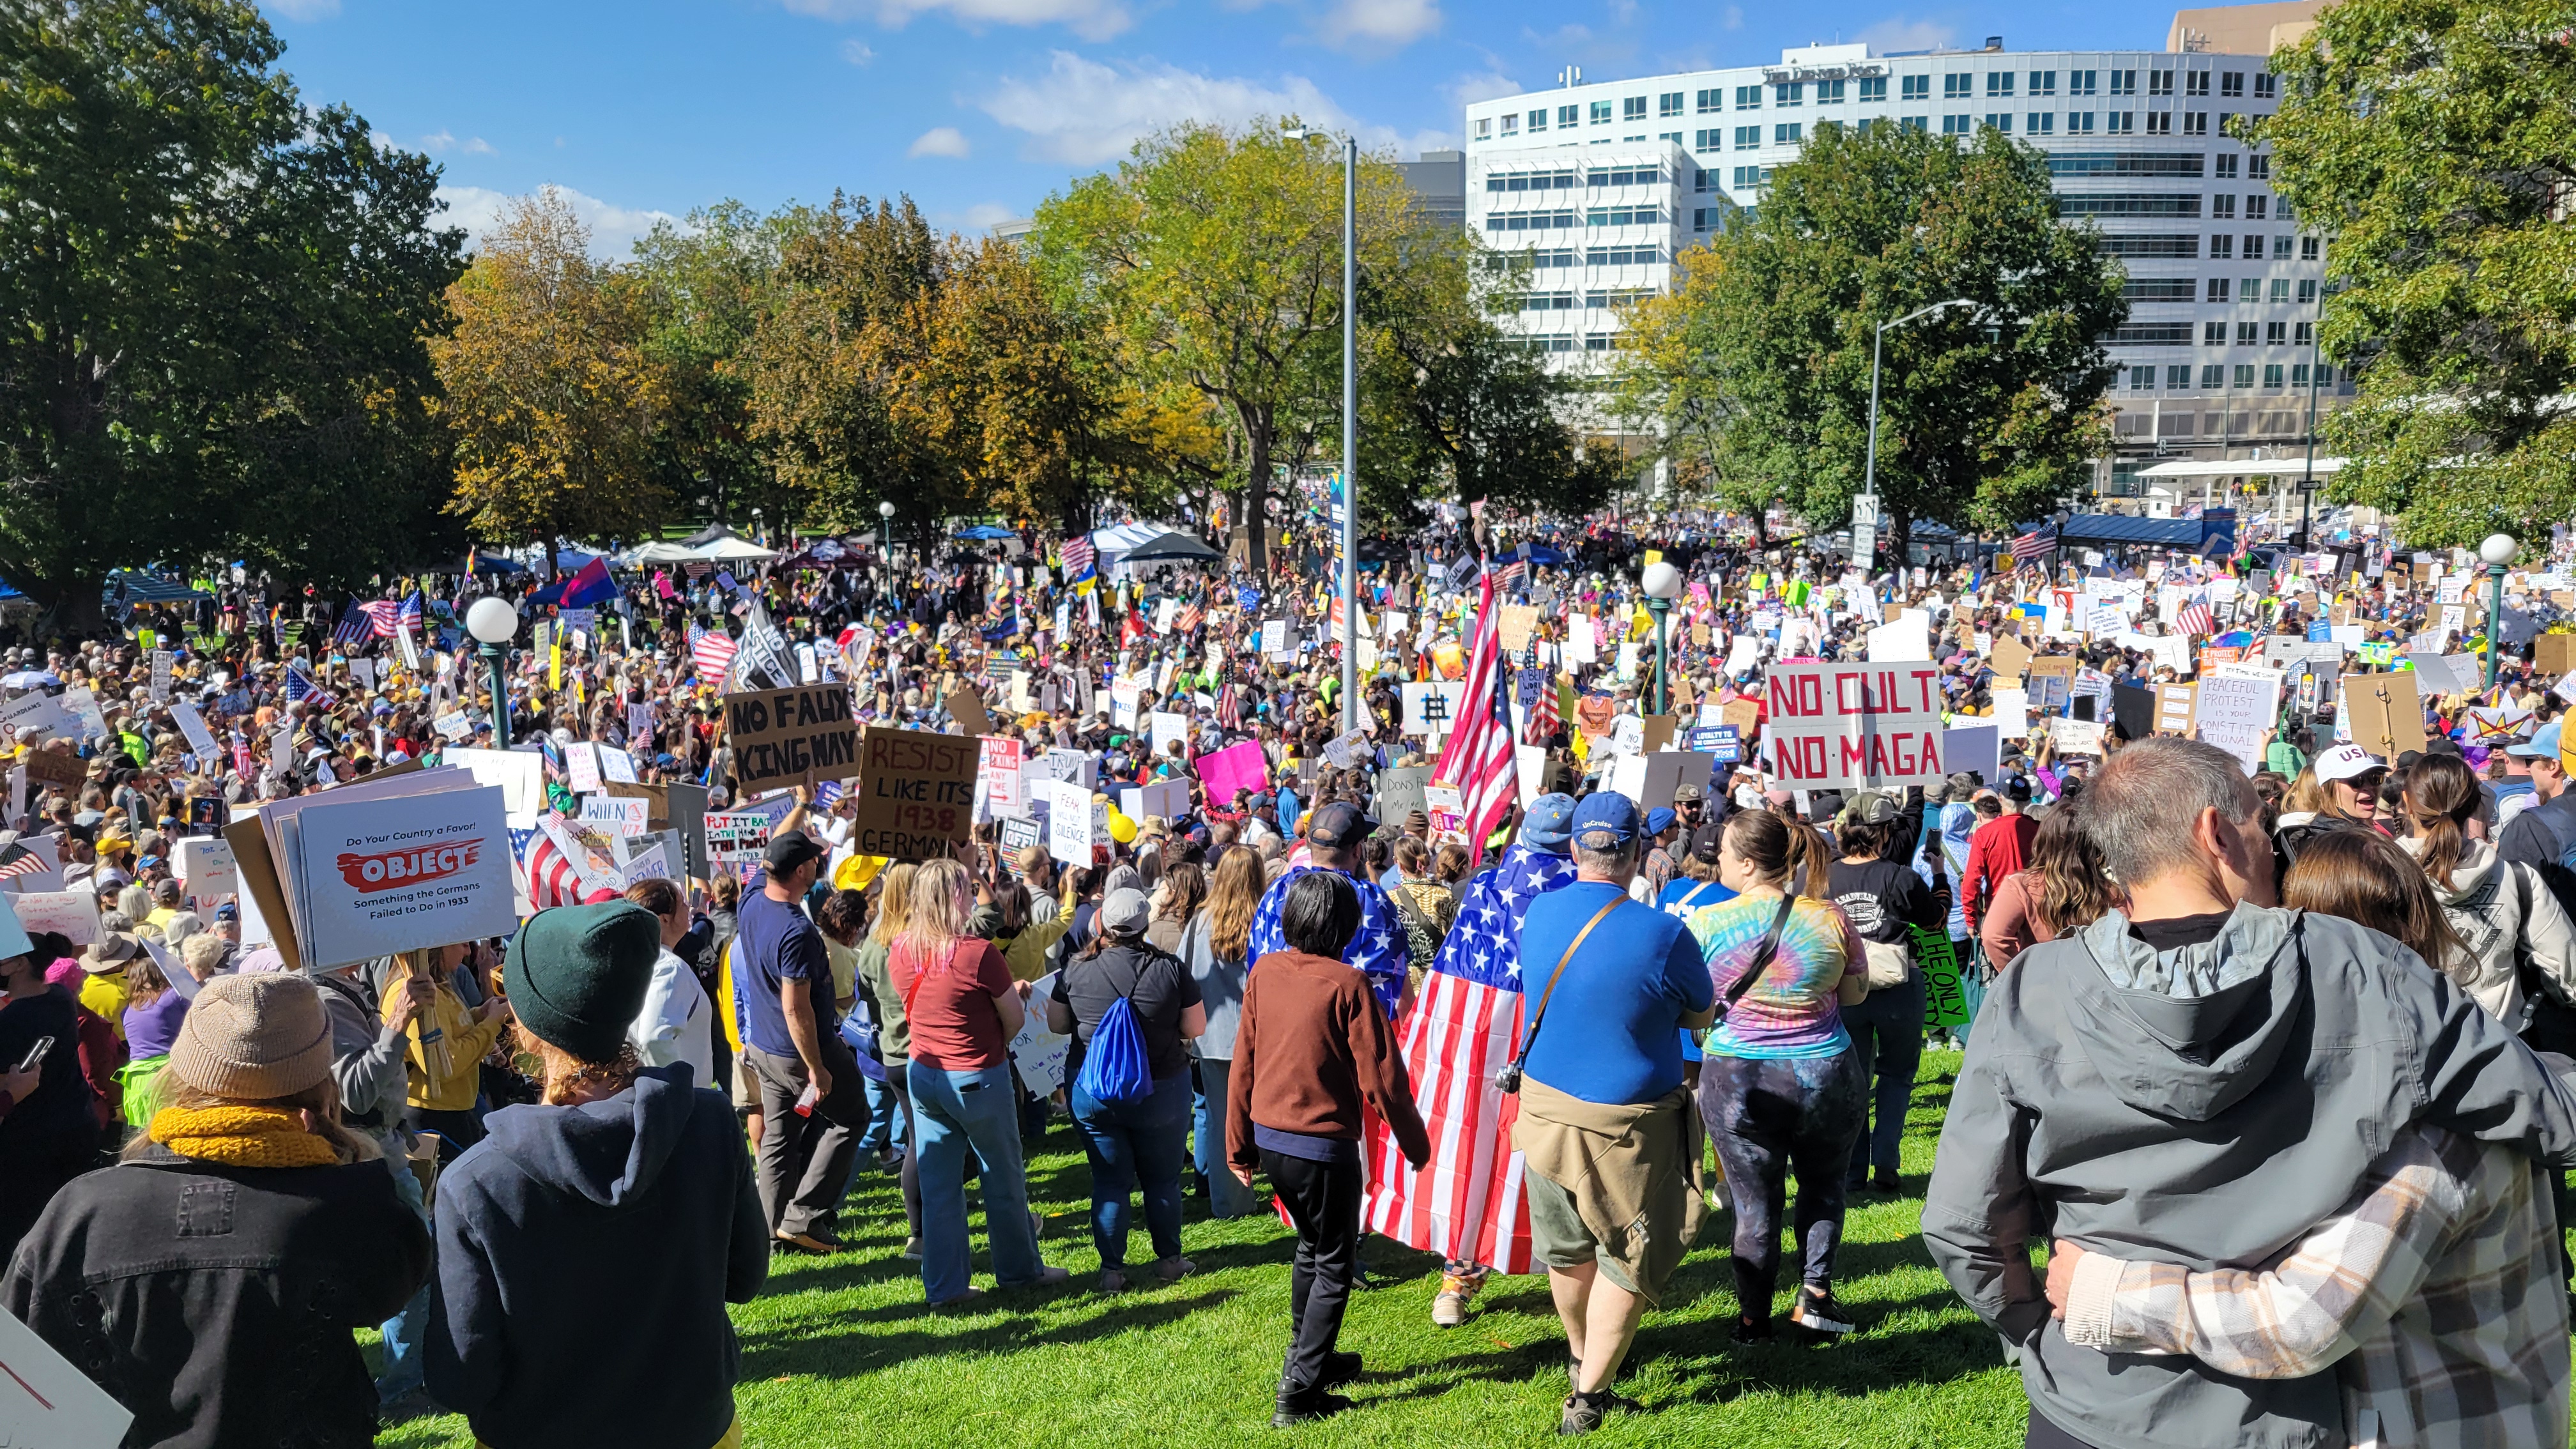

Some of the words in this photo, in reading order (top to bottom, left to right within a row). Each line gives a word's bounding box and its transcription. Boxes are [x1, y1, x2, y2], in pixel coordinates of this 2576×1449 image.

[1428, 634, 1457, 652] TRAITOR
[1770, 673, 1823, 717] NO
[1835, 670, 1936, 716] CULT
[2207, 678, 2259, 694] PEACEFUL
[733, 699, 769, 734] NO
[774, 686, 853, 729] FAUX
[2204, 693, 2255, 709] PROTEST
[2199, 719, 2256, 735] CONSTIT
[2230, 710, 2251, 719] YOUR
[871, 737, 974, 775] RESIST
[990, 740, 1008, 755] NO
[1775, 735, 1828, 781] NO
[1839, 732, 1942, 778] MAGA
[877, 776, 930, 801] LIKE
[937, 780, 974, 806] IT'S
[706, 816, 730, 829] PUT
[733, 817, 747, 828] IT
[894, 804, 956, 829] 1938
[1582, 820, 1612, 829] UnCruise
[346, 837, 362, 847] Do
[365, 834, 390, 845] Your
[392, 827, 434, 842] Country
[436, 827, 443, 835] a
[446, 822, 477, 834] Favor!
[362, 847, 471, 882] OBJECT
[353, 893, 415, 909] Something
[417, 889, 434, 900] the
[436, 882, 481, 896] Germans
[369, 907, 403, 921] Failed
[405, 905, 417, 914] to
[419, 903, 434, 912] Do
[436, 900, 446, 909] in
[447, 896, 470, 907] 1933
[1923, 929, 1953, 969] THE
[1931, 972, 1964, 1016] ONLY
